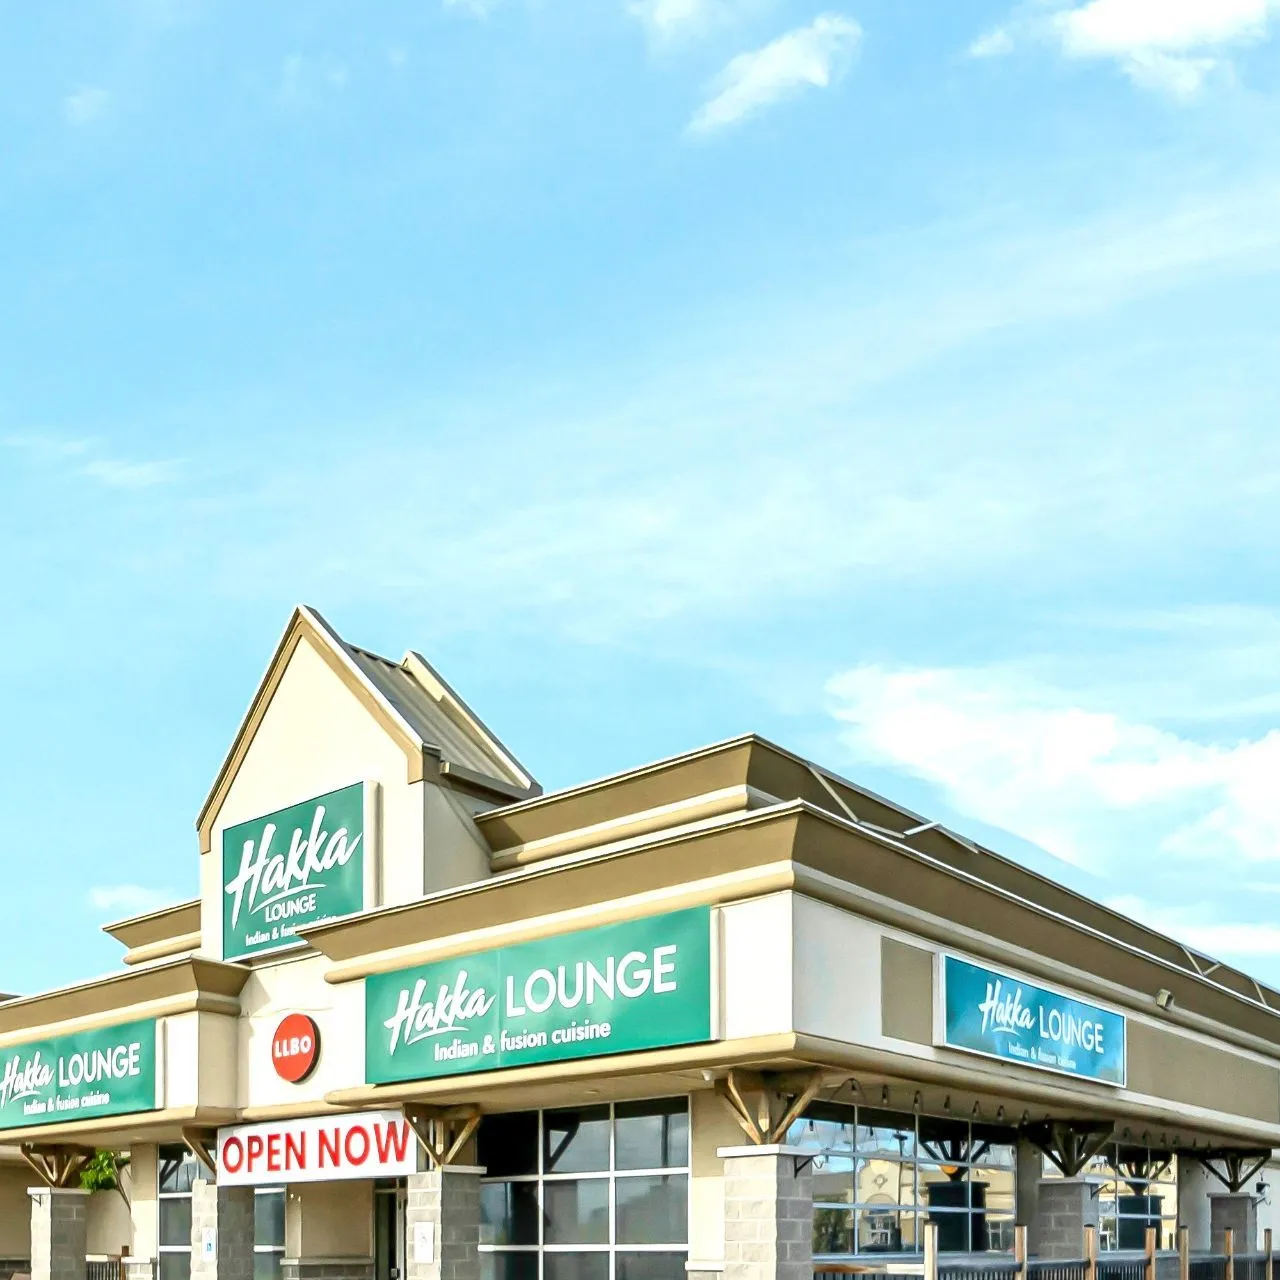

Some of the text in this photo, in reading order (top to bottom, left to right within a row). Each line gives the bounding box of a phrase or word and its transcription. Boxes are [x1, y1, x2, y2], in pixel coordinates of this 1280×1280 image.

[225, 805, 362, 931] Hakka
[264, 893, 317, 923] LOUNGE
[245, 930, 271, 946] Indian
[271, 926, 279, 940] &
[383, 944, 677, 1056] Hakka LOUNGE
[978, 979, 1104, 1054] Hakka LOUNGE
[274, 1035, 312, 1058] LLBO
[434, 1019, 611, 1062] Indian & fusion cuisine
[58, 1042, 141, 1087] LOUNGE
[23, 1090, 110, 1116] Indian & fusion cuisine
[222, 1120, 411, 1174] OPEN NOW
